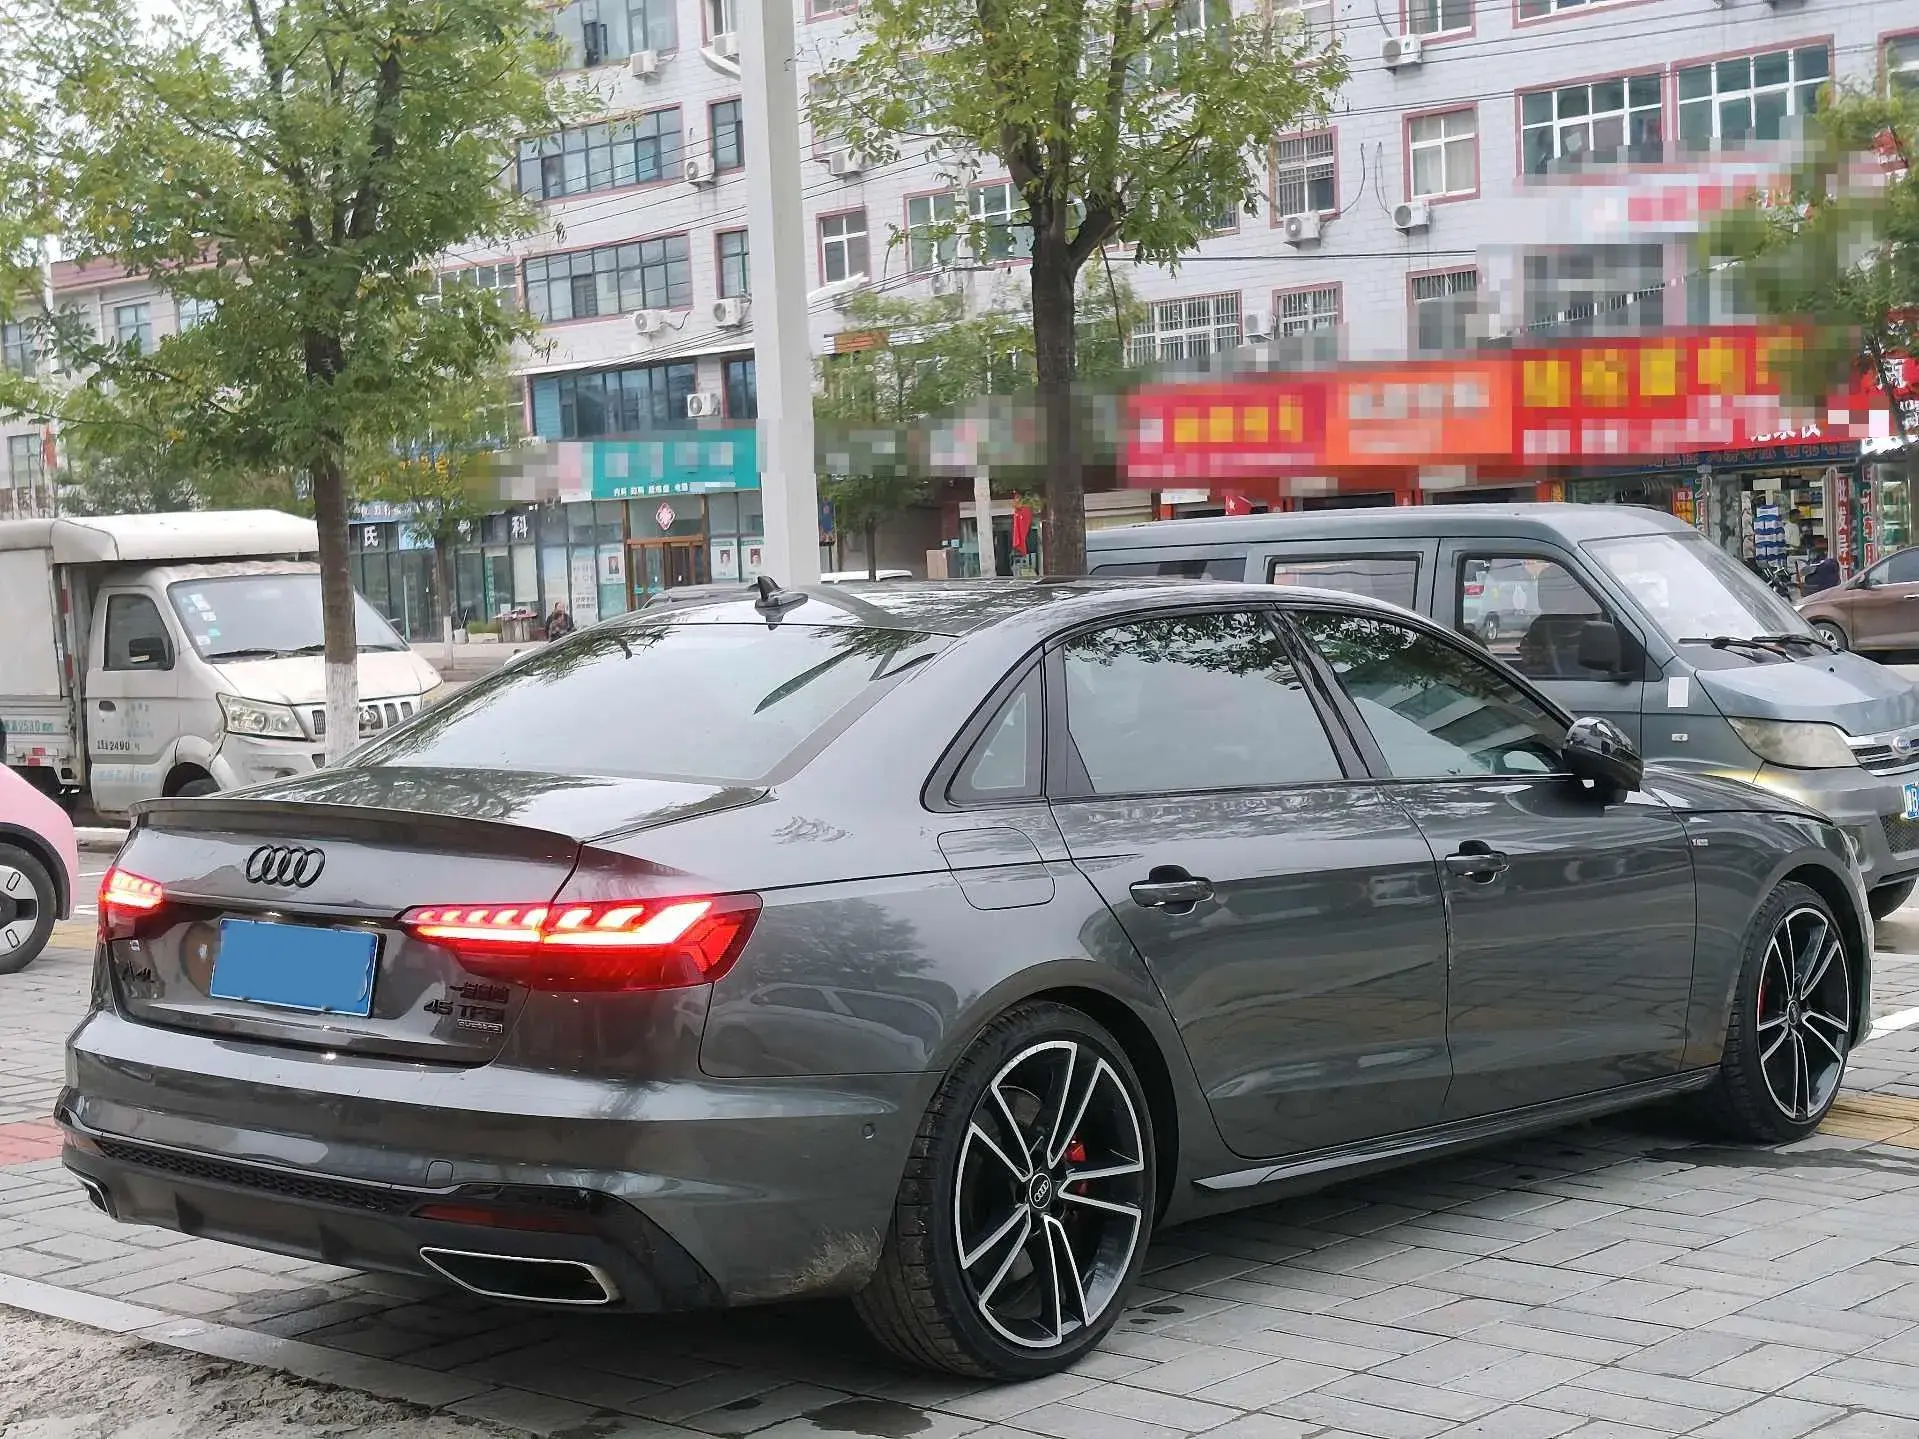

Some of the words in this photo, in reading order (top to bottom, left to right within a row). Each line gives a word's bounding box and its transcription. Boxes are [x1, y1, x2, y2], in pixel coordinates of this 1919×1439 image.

[363, 525, 380, 548] 氏
[511, 514, 528, 539] 科
[424, 1000, 453, 1015] 45
